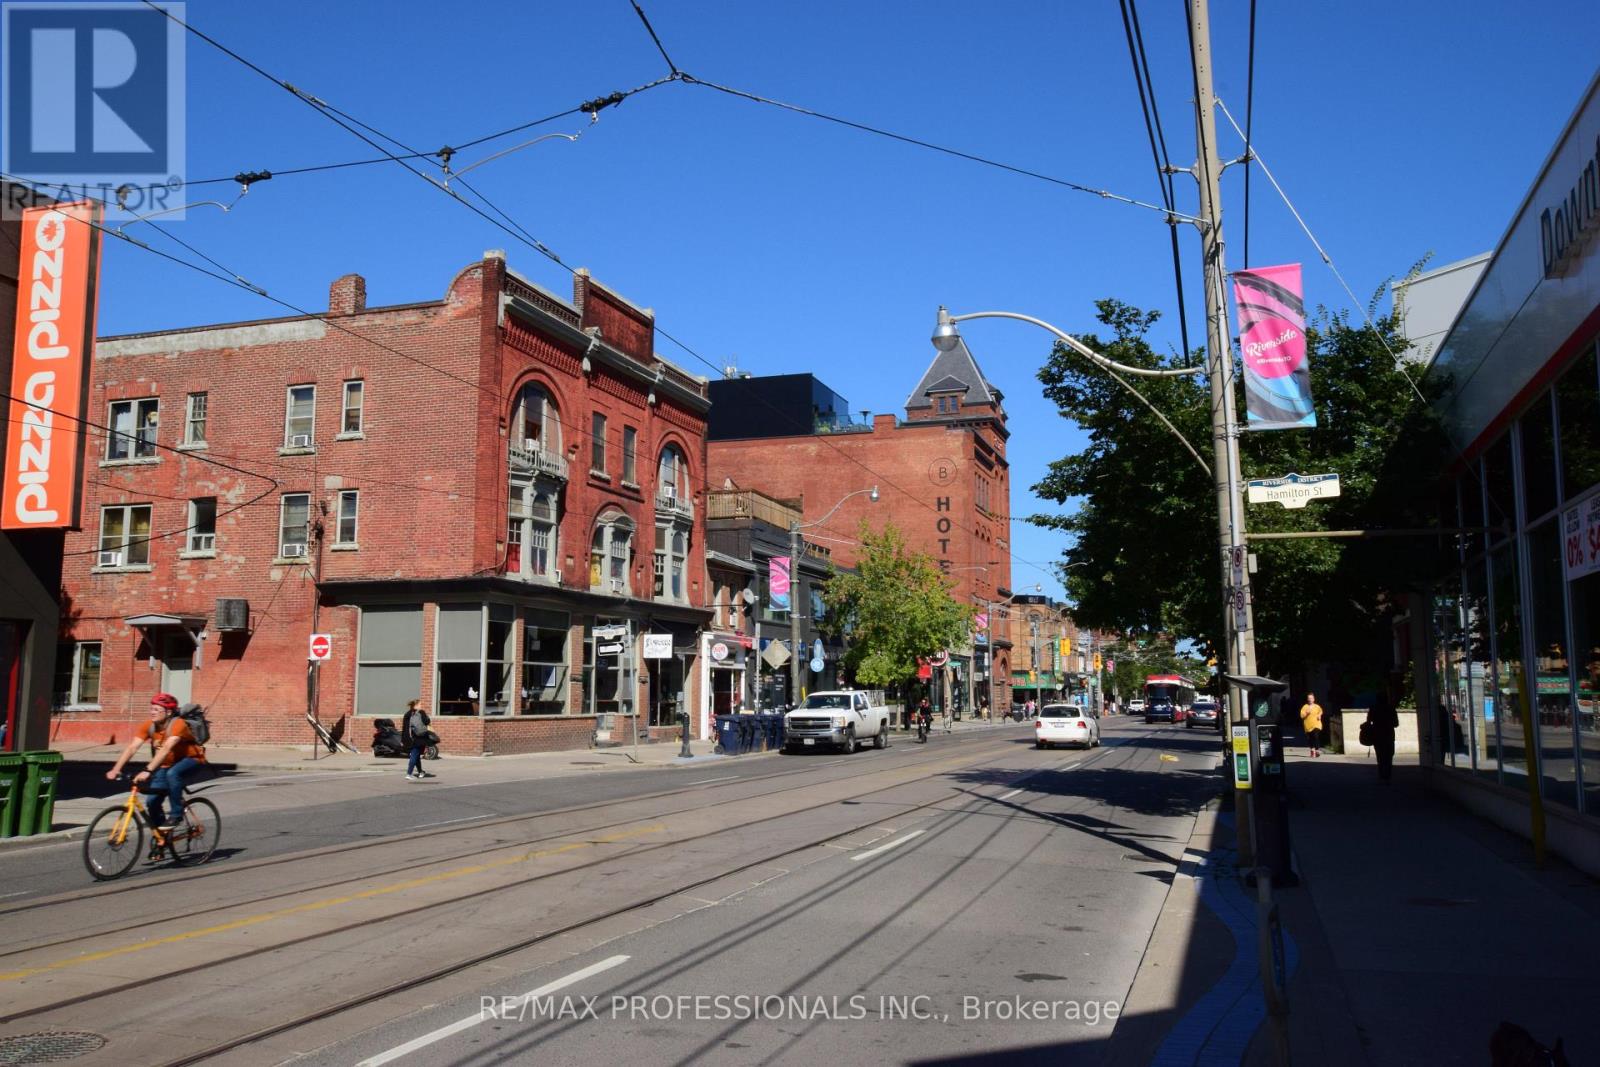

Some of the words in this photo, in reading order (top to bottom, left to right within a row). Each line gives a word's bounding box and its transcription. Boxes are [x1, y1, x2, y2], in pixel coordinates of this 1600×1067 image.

[27, 210, 70, 361] pizza
[1245, 328, 1298, 358] Riverside
[15, 370, 59, 524] pizza
[938, 467, 948, 479] B
[1262, 479, 1293, 487] RIVERSIDE
[1297, 476, 1323, 484] DISTRICT
[1266, 488, 1310, 500] Hamilton
[1313, 486, 1324, 496] St
[1567, 533, 1584, 568] 0%
